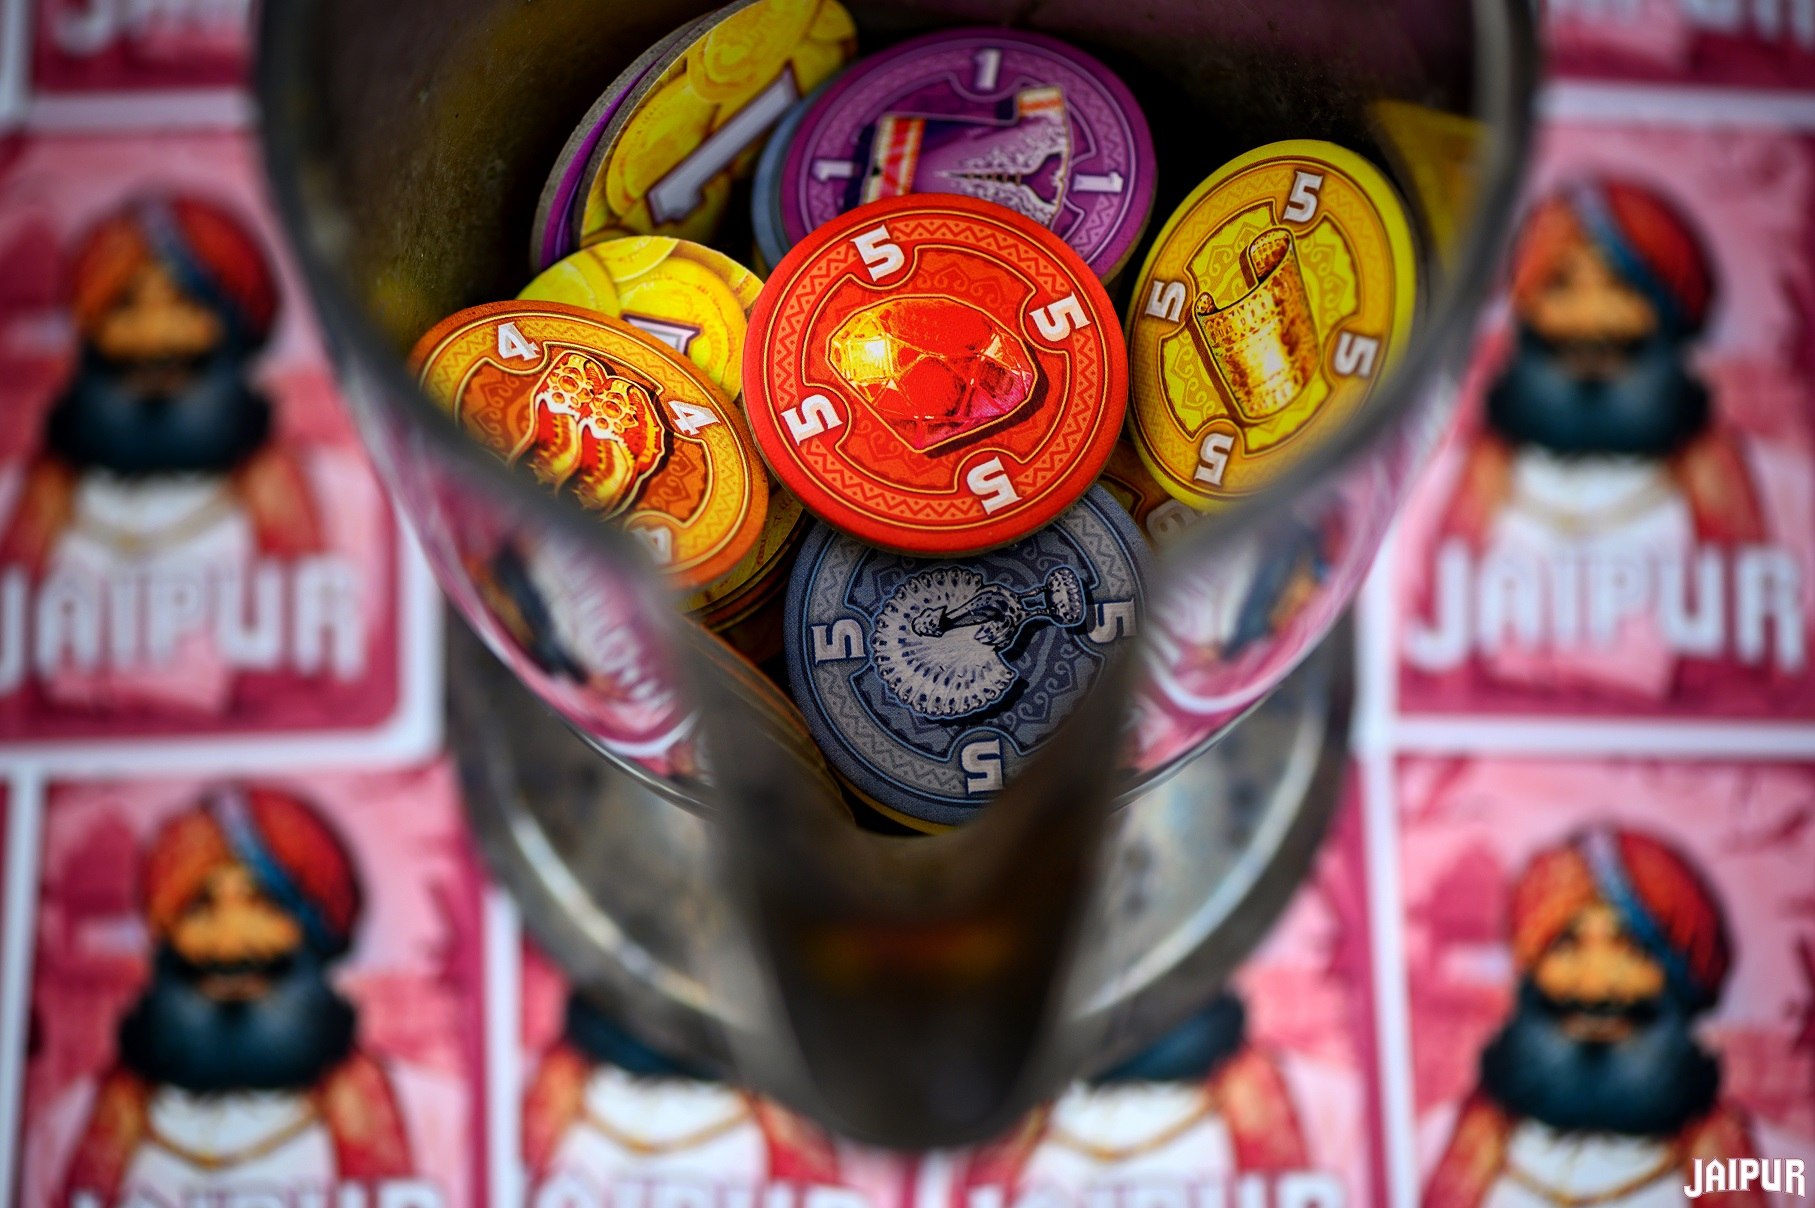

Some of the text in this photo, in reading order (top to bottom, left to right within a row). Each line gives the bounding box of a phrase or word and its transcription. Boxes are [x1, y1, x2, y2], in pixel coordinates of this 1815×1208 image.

[973, 48, 1000, 90] 1
[815, 159, 854, 182] 1
[1077, 170, 1124, 195] 1
[1283, 170, 1324, 223] 5
[850, 224, 905, 282] 5
[1029, 292, 1091, 343] 5
[1145, 280, 1186, 322] 5
[497, 321, 540, 362] 4
[1334, 330, 1380, 377] 5
[668, 399, 720, 436] 4
[781, 394, 843, 446] 5
[1194, 432, 1235, 486] 5
[967, 456, 1022, 515] 5
[1091, 599, 1137, 643] 5
[1408, 538, 1807, 676] JAIPUR
[812, 618, 867, 666] 5
[960, 739, 1003, 794] 5
